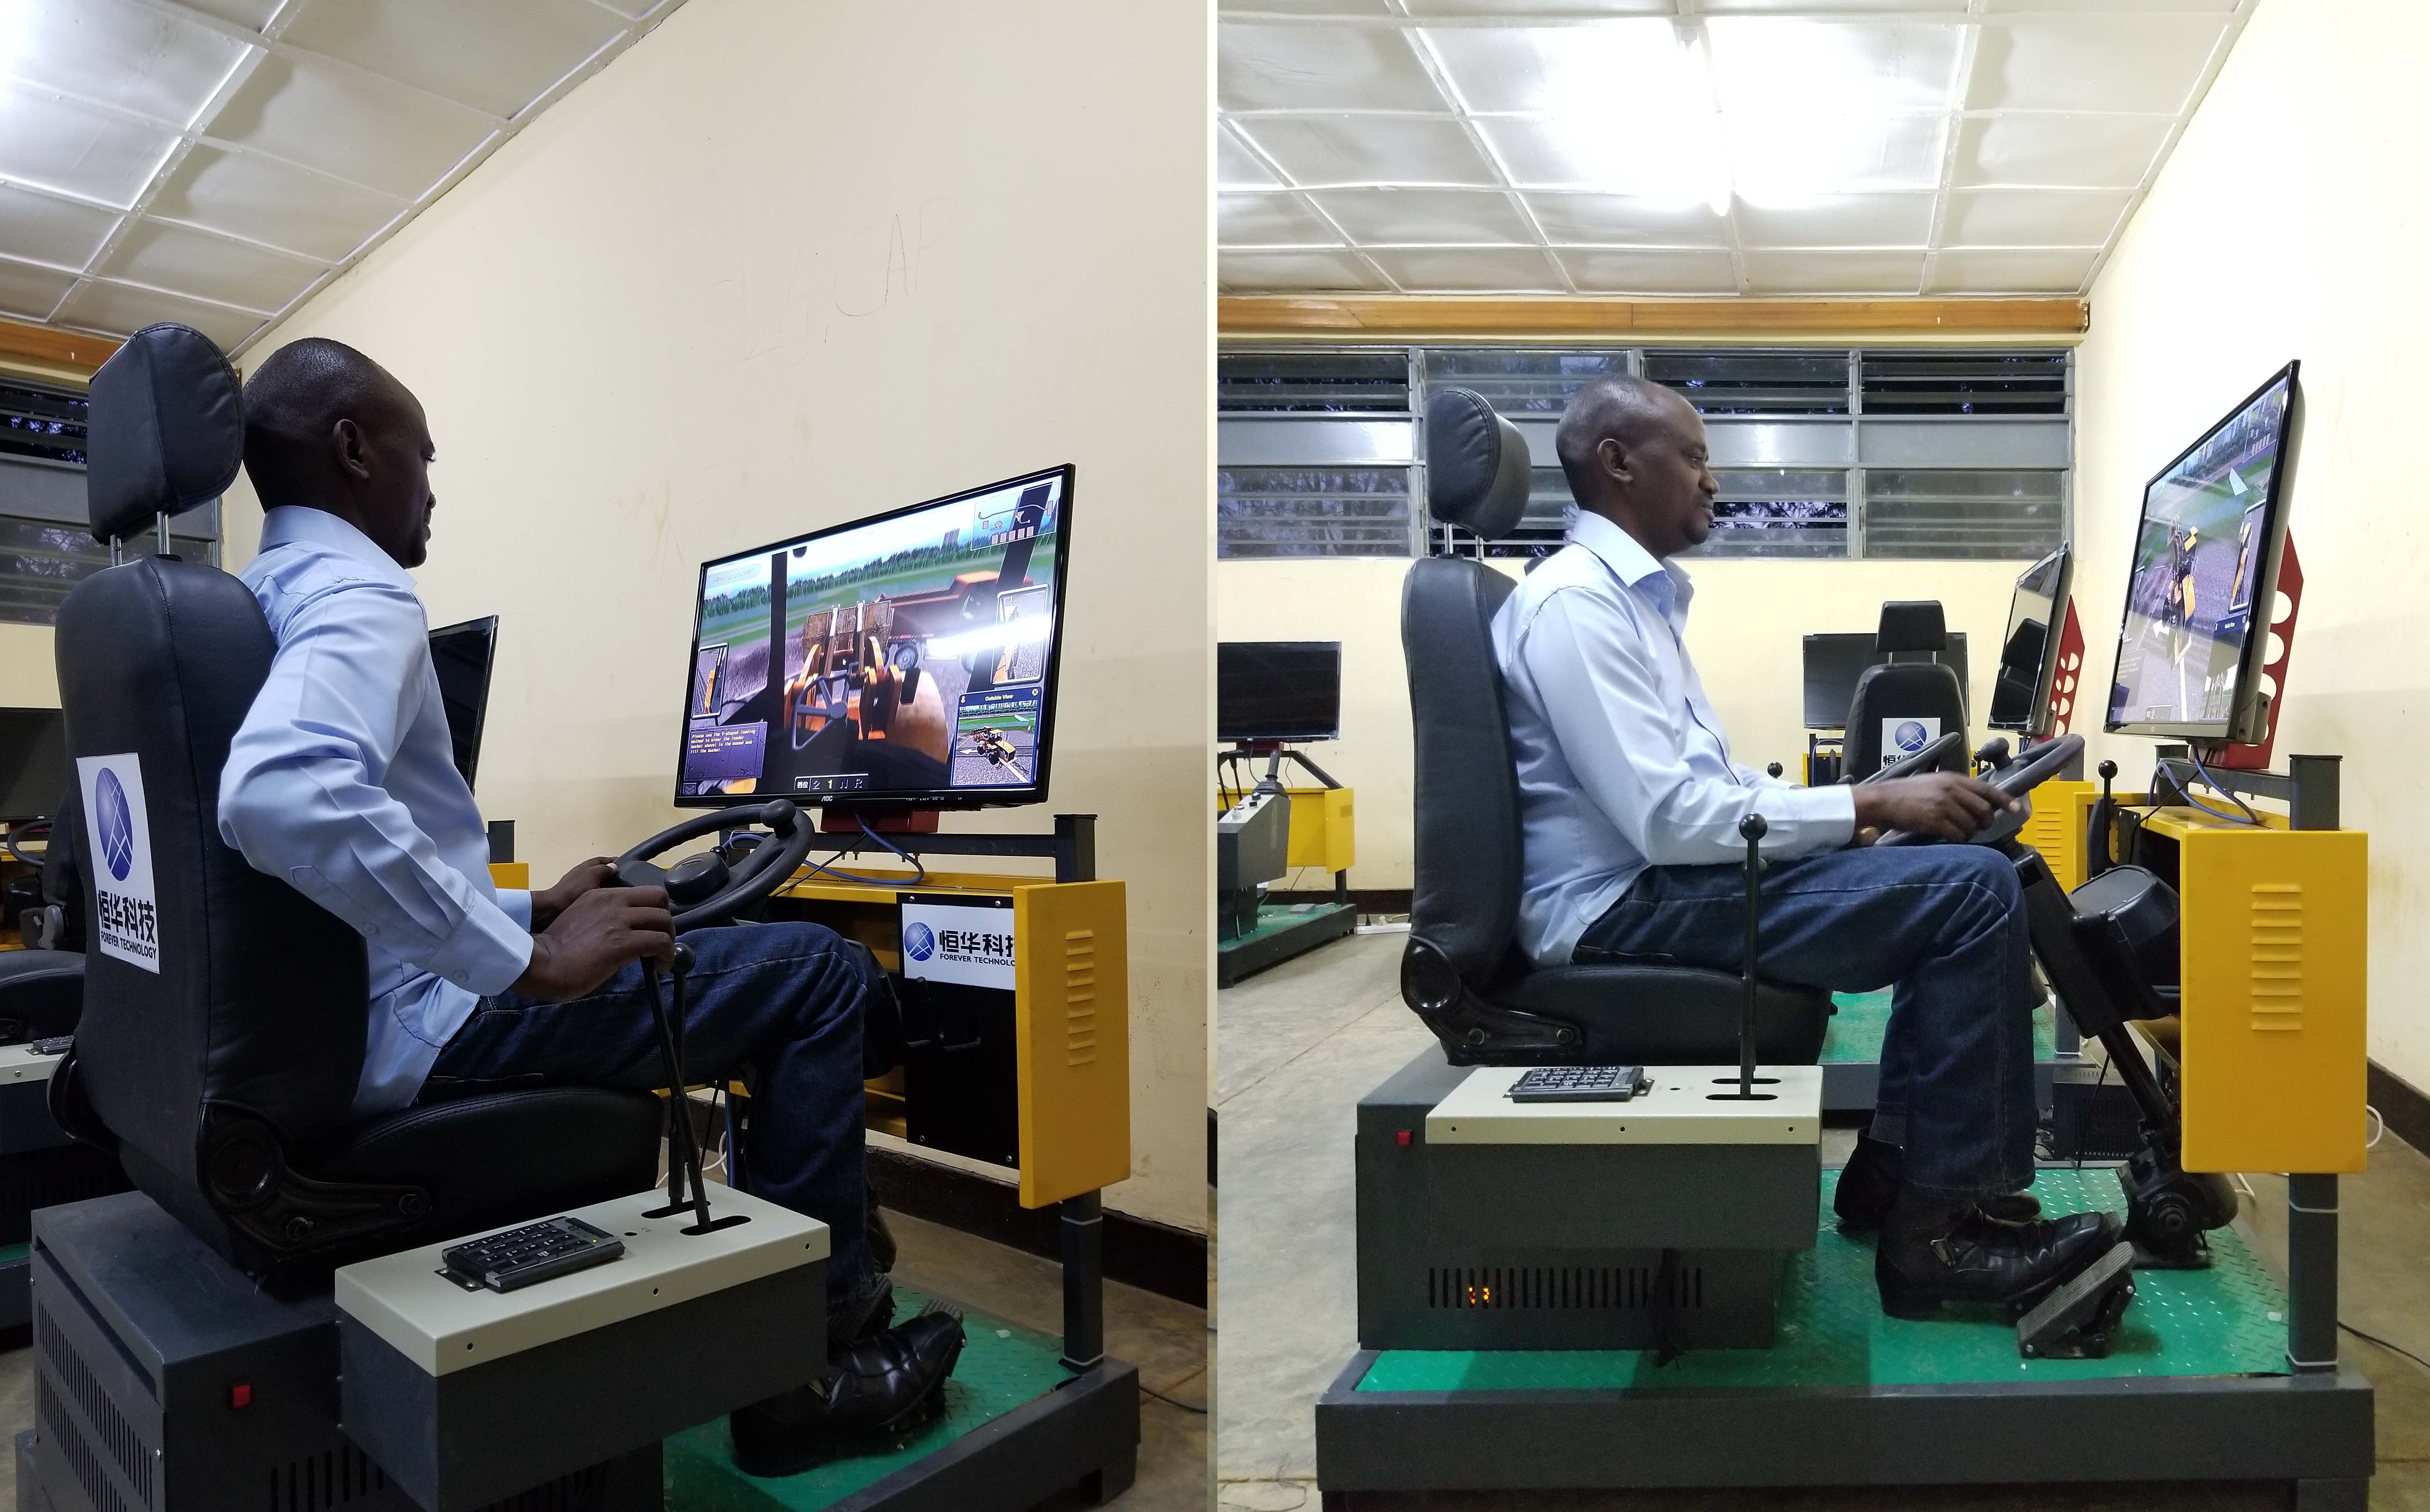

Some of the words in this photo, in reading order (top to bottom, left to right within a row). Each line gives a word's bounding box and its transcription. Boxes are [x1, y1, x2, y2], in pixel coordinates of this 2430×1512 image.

[812, 781, 820, 790] 2
[828, 779, 833, 789] 1
[840, 779, 848, 789] N
[854, 779, 863, 788] R
[98, 890, 155, 944] 恒华科技
[101, 930, 119, 948] FOREVER
[120, 938, 156, 960] TECHNOLOGY
[940, 953, 971, 962] FOREVER
